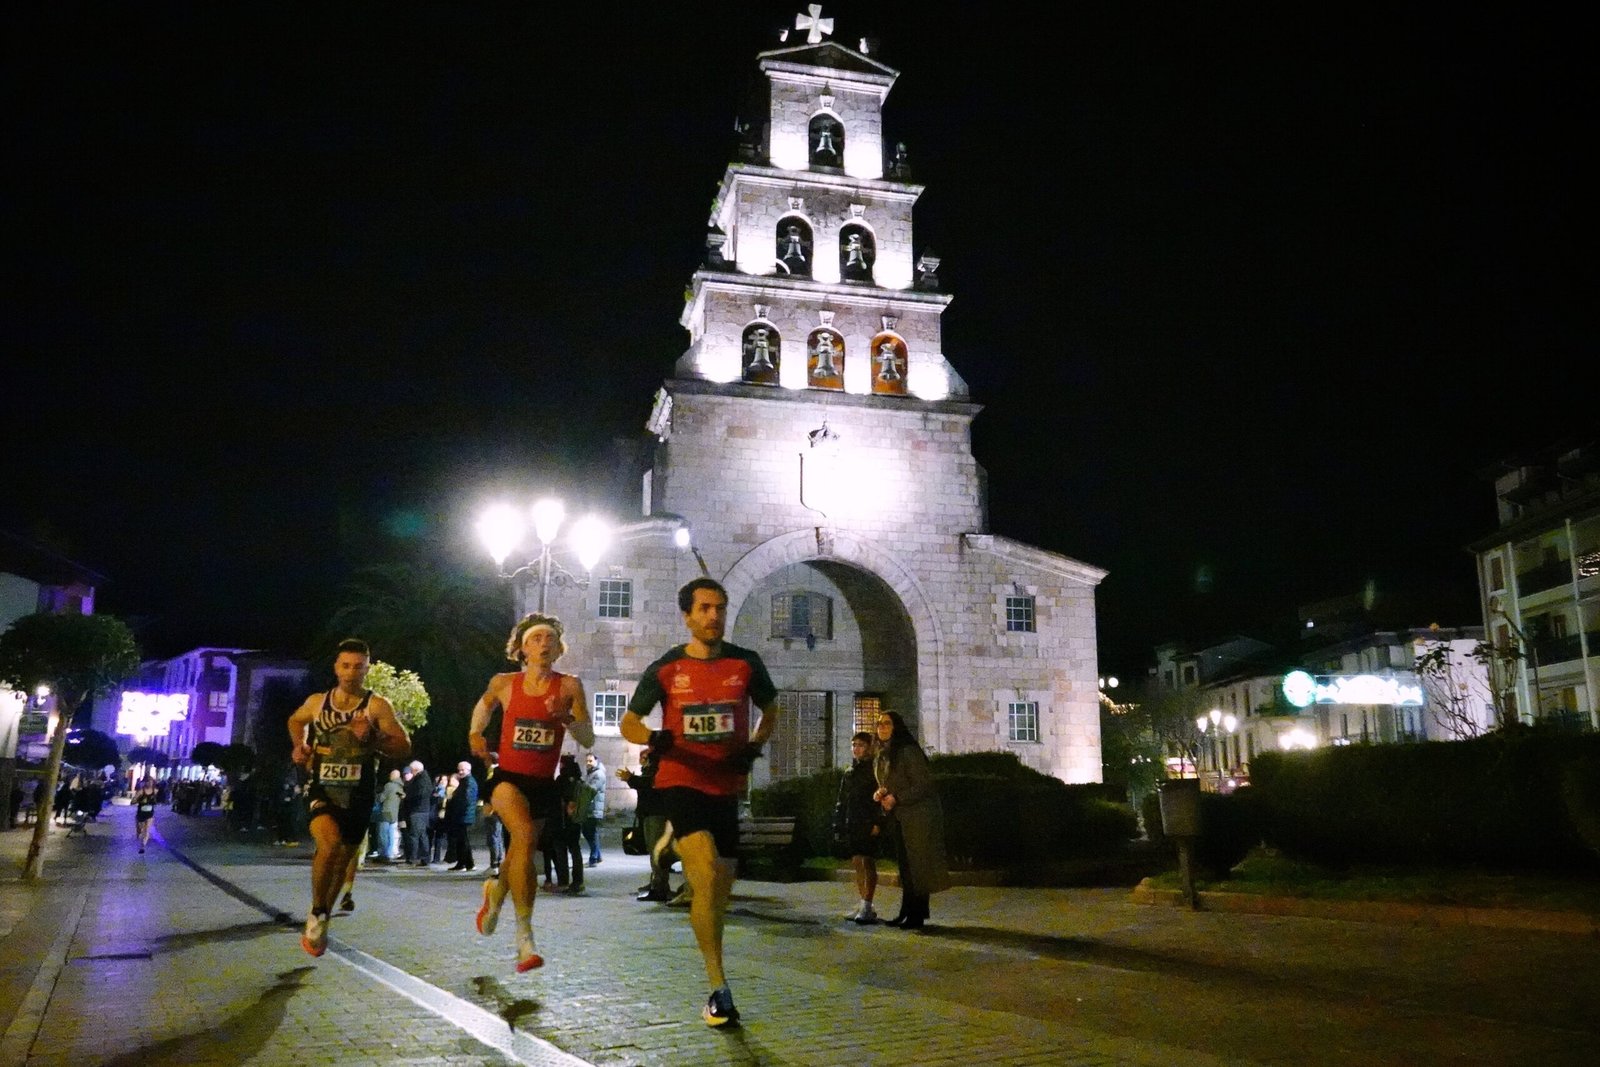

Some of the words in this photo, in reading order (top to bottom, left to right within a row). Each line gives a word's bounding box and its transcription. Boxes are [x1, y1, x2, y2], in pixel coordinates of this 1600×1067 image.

[689, 716, 716, 732] 418
[516, 728, 541, 743] 262
[323, 765, 348, 778] 250
